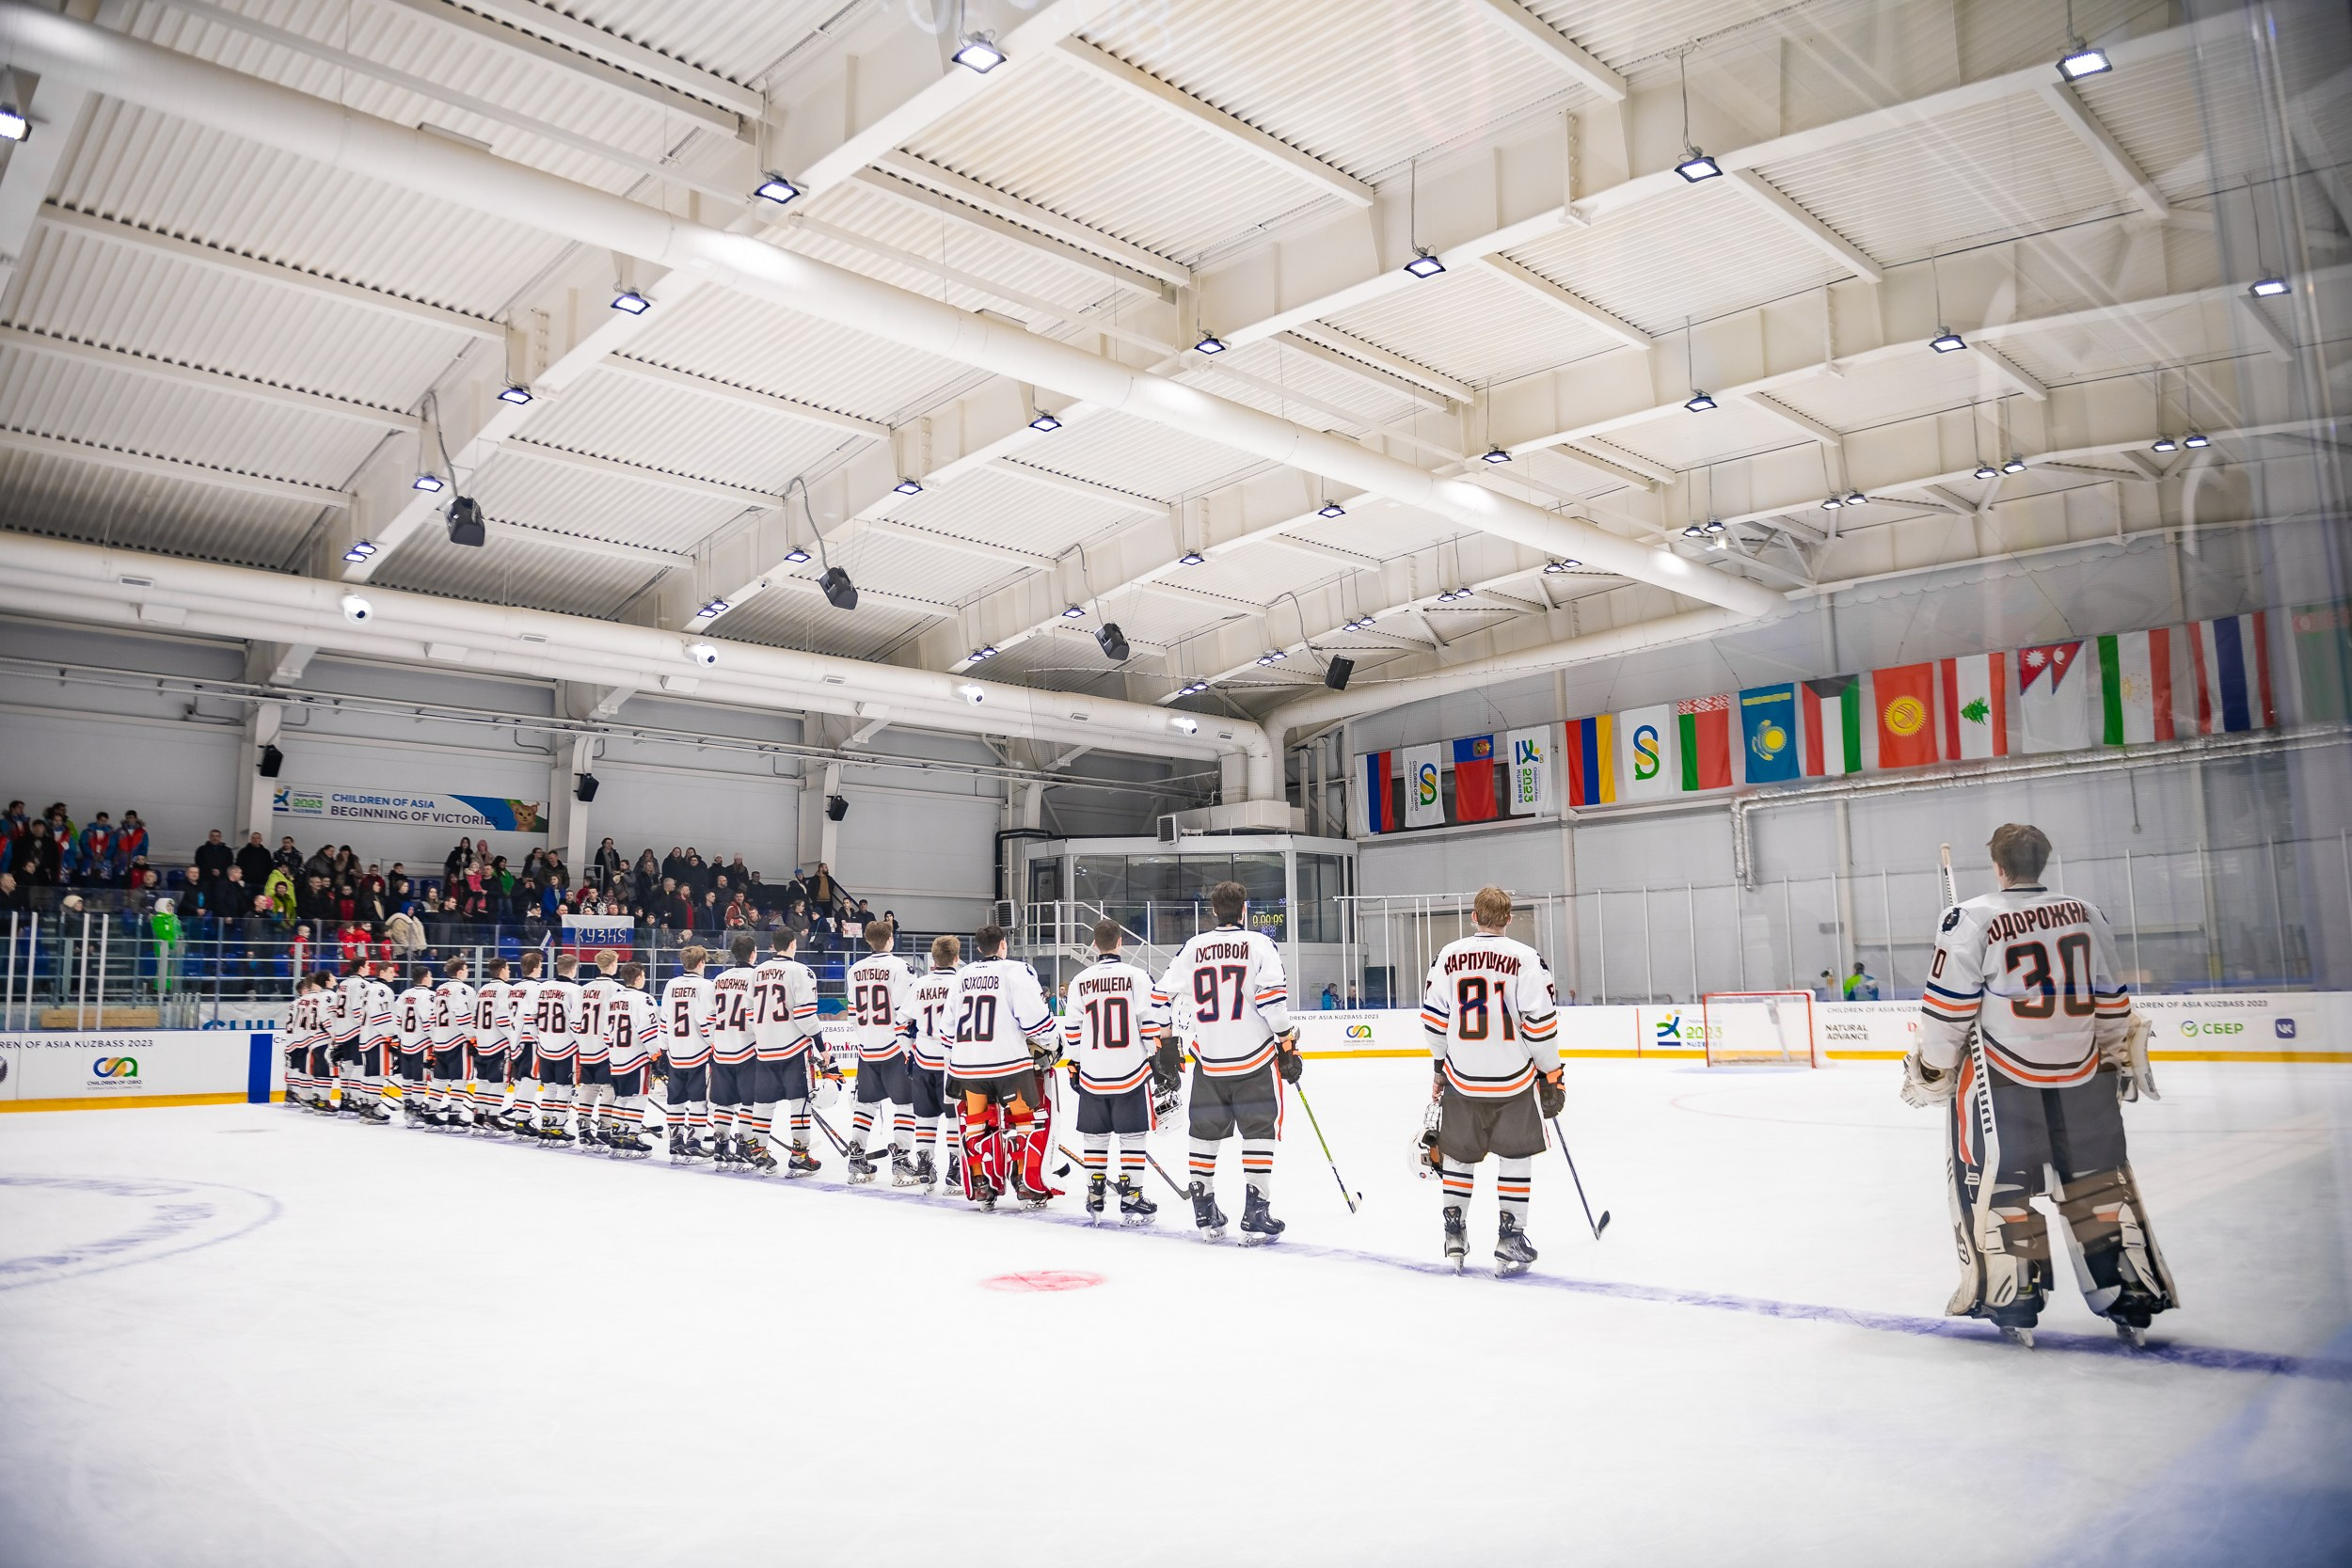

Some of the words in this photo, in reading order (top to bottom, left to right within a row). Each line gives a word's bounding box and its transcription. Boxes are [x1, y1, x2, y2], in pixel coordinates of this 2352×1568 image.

[331, 793, 390, 806] CHILDREN
[393, 797, 408, 808] OF
[410, 799, 436, 809] ASIA
[1522, 768, 1534, 803] 2023
[330, 805, 409, 821] BEGINNING
[411, 810, 429, 822] OF
[432, 812, 499, 826] VICTORIES
[574, 927, 627, 943] КУЗНЯ
[1079, 976, 1133, 996] ПРИЩЕПА
[2005, 932, 2096, 1020] 30
[754, 984, 789, 1024] 73
[855, 984, 892, 1025] 99
[1193, 964, 1248, 1023] 97
[1456, 975, 1516, 1041] 81
[2131, 1001, 2164, 1009] ILDREN
[2204, 1000, 2245, 1008] KUZBASS
[537, 1002, 566, 1034] 88
[580, 1002, 601, 1035] 61
[674, 1001, 690, 1037] 5
[715, 993, 747, 1032] 24
[956, 995, 997, 1043] 20
[1085, 997, 1131, 1050] 10
[2202, 1022, 2244, 1035] СБЕР
[25, 1040, 41, 1049] OF
[46, 1040, 71, 1049] ASIA
[74, 1039, 125, 1049] KUZBASS
[128, 1038, 154, 1047] 2023
[1686, 1026, 1723, 1038] 2023
